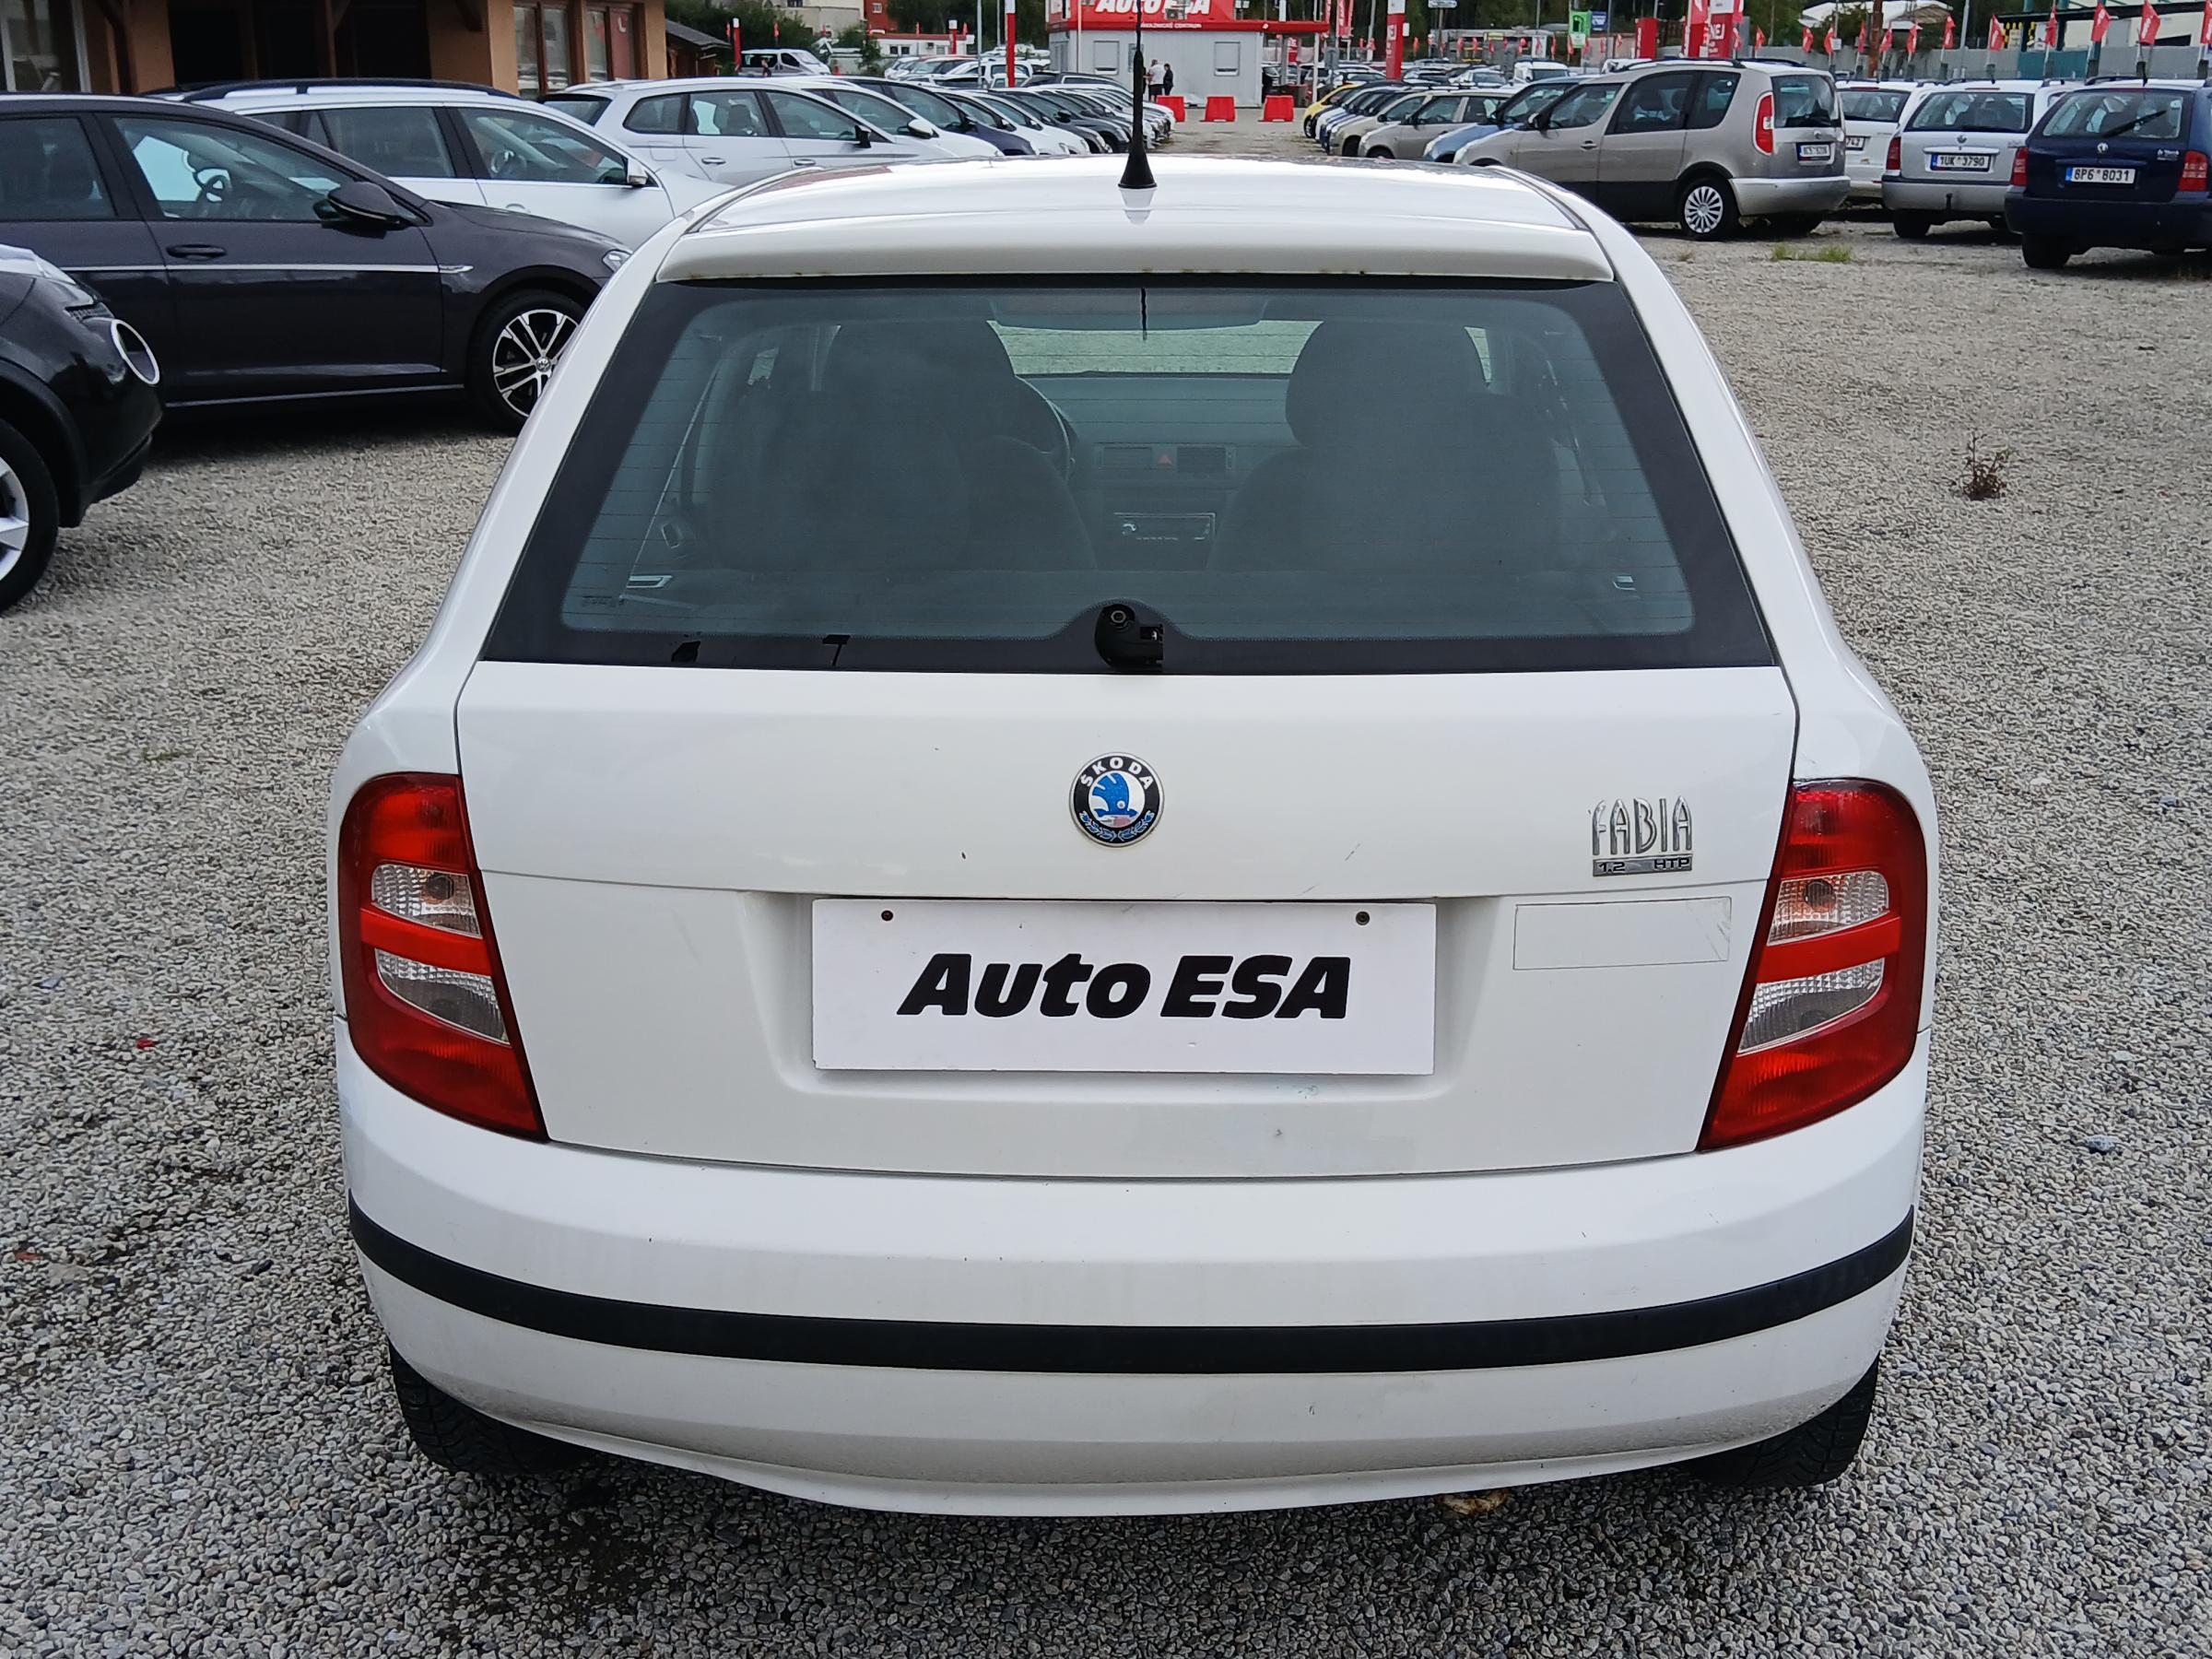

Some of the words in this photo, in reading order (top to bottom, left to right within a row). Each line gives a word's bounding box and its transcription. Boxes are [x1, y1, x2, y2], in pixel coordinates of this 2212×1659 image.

[2101, 170, 2130, 182] 8031
[1592, 795, 1692, 855] FABIA
[1598, 862, 1626, 872] 1.2
[1654, 857, 1689, 869] HTP
[896, 953, 1152, 1018] Auto
[1159, 955, 1351, 1019] ESA
